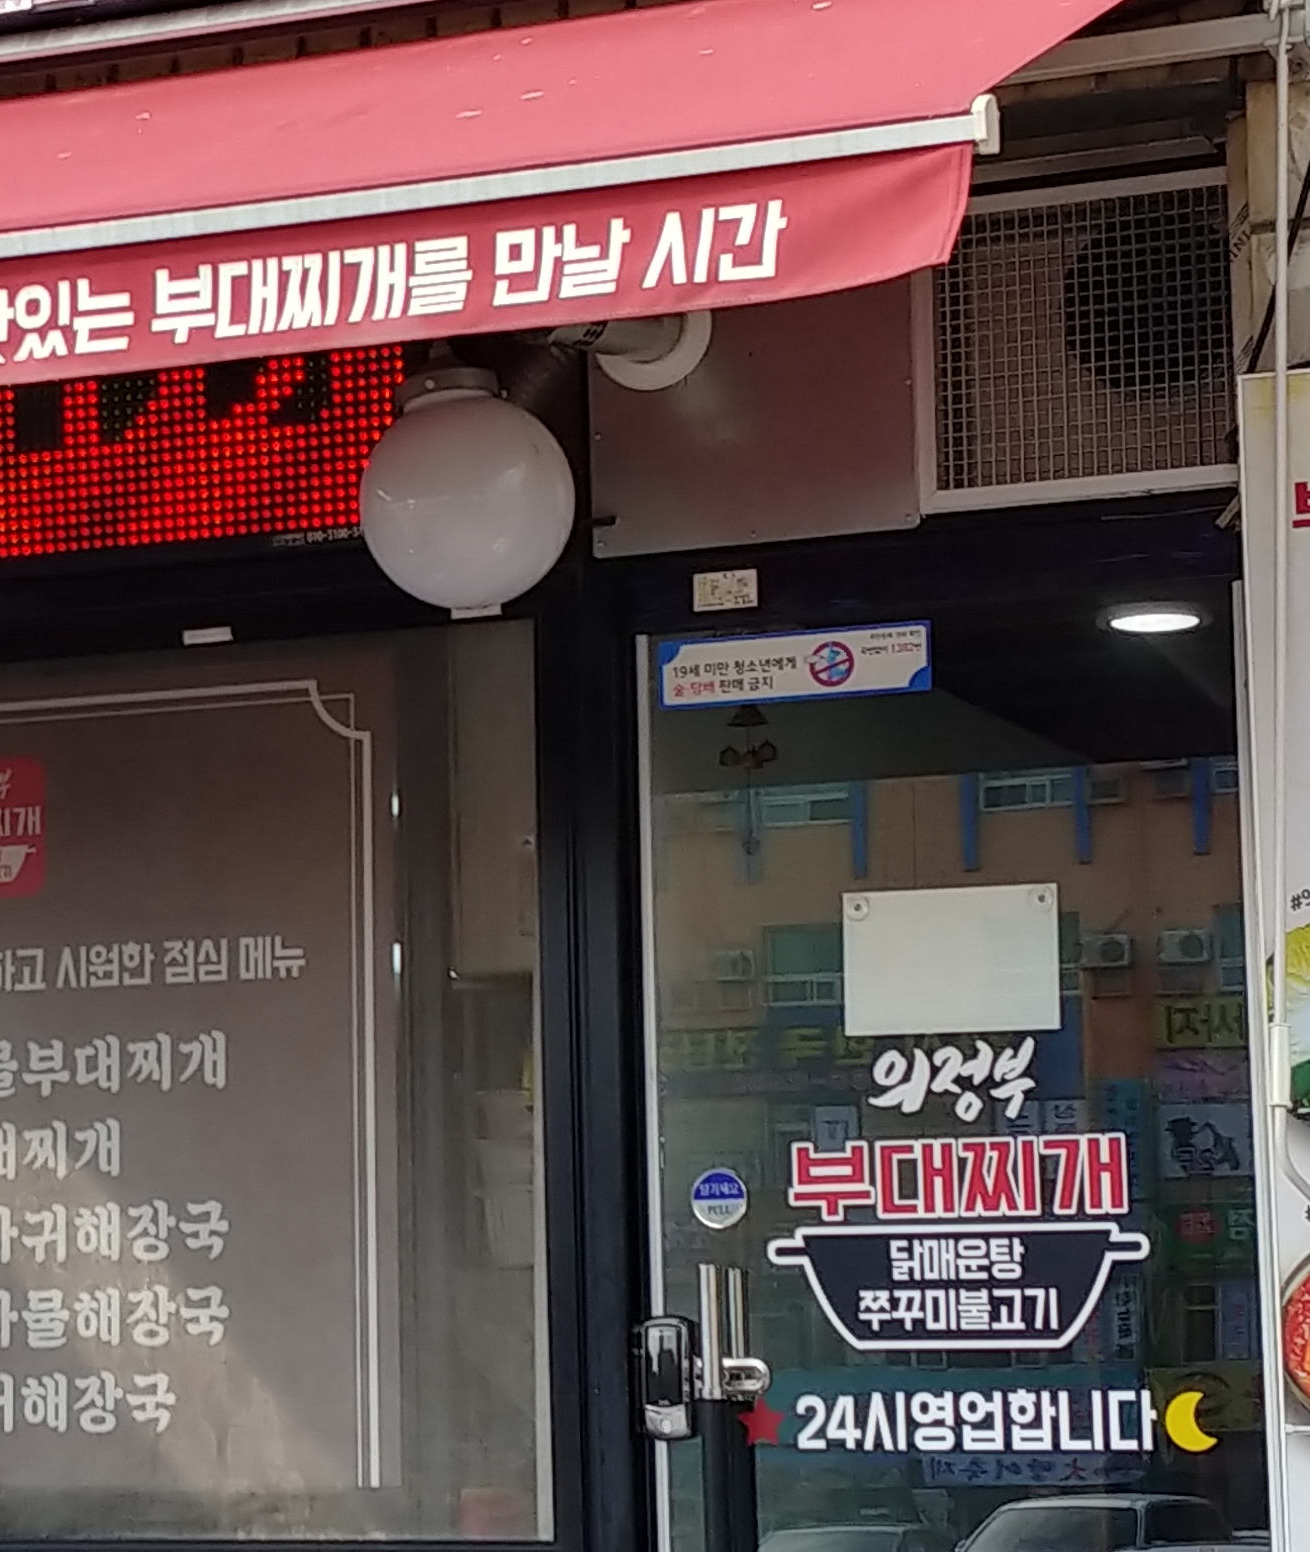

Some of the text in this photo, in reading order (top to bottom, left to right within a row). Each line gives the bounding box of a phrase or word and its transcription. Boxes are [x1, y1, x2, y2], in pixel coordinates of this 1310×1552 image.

[151, 234, 472, 344] 부대찌개를
[490, 218, 631, 306] 만날
[642, 199, 787, 288] 시간
[703, 660, 729, 677] 미만
[732, 655, 798, 676] 청소년에게
[718, 677, 745, 694] 판매
[747, 675, 775, 691] 금지
[56, 942, 155, 990] 시원한
[163, 937, 229, 987] 점심
[239, 935, 307, 982] 메뉴
[867, 1036, 1037, 1122] 의정부
[788, 1132, 1130, 1222] 부대찌개
[889, 1238, 1026, 1281] 닭매운탕
[857, 1286, 1060, 1333] 쭈꾸미불고기
[794, 1388, 1158, 1453] 24시영업합니다
